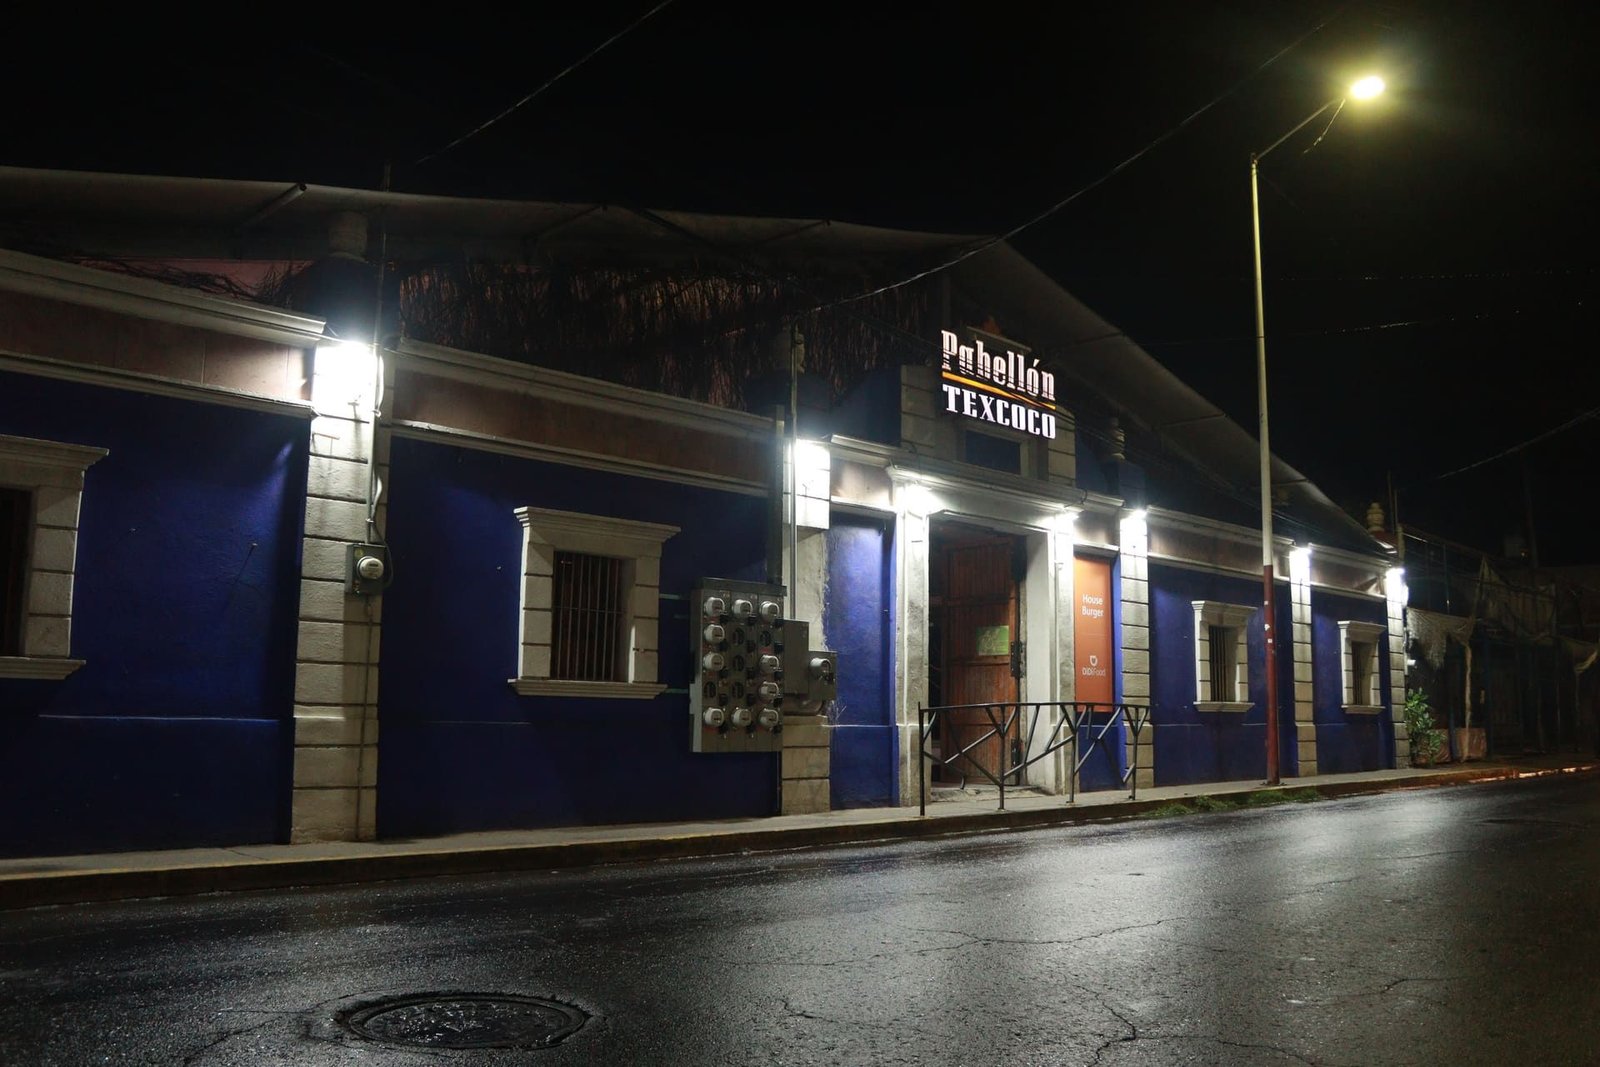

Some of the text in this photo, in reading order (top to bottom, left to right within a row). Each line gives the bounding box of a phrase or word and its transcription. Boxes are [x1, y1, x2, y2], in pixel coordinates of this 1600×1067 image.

[941, 330, 1055, 400] Pabellón
[942, 383, 1056, 439] TEXCOCO
[1082, 594, 1103, 605] House
[1082, 606, 1103, 618] Burger
